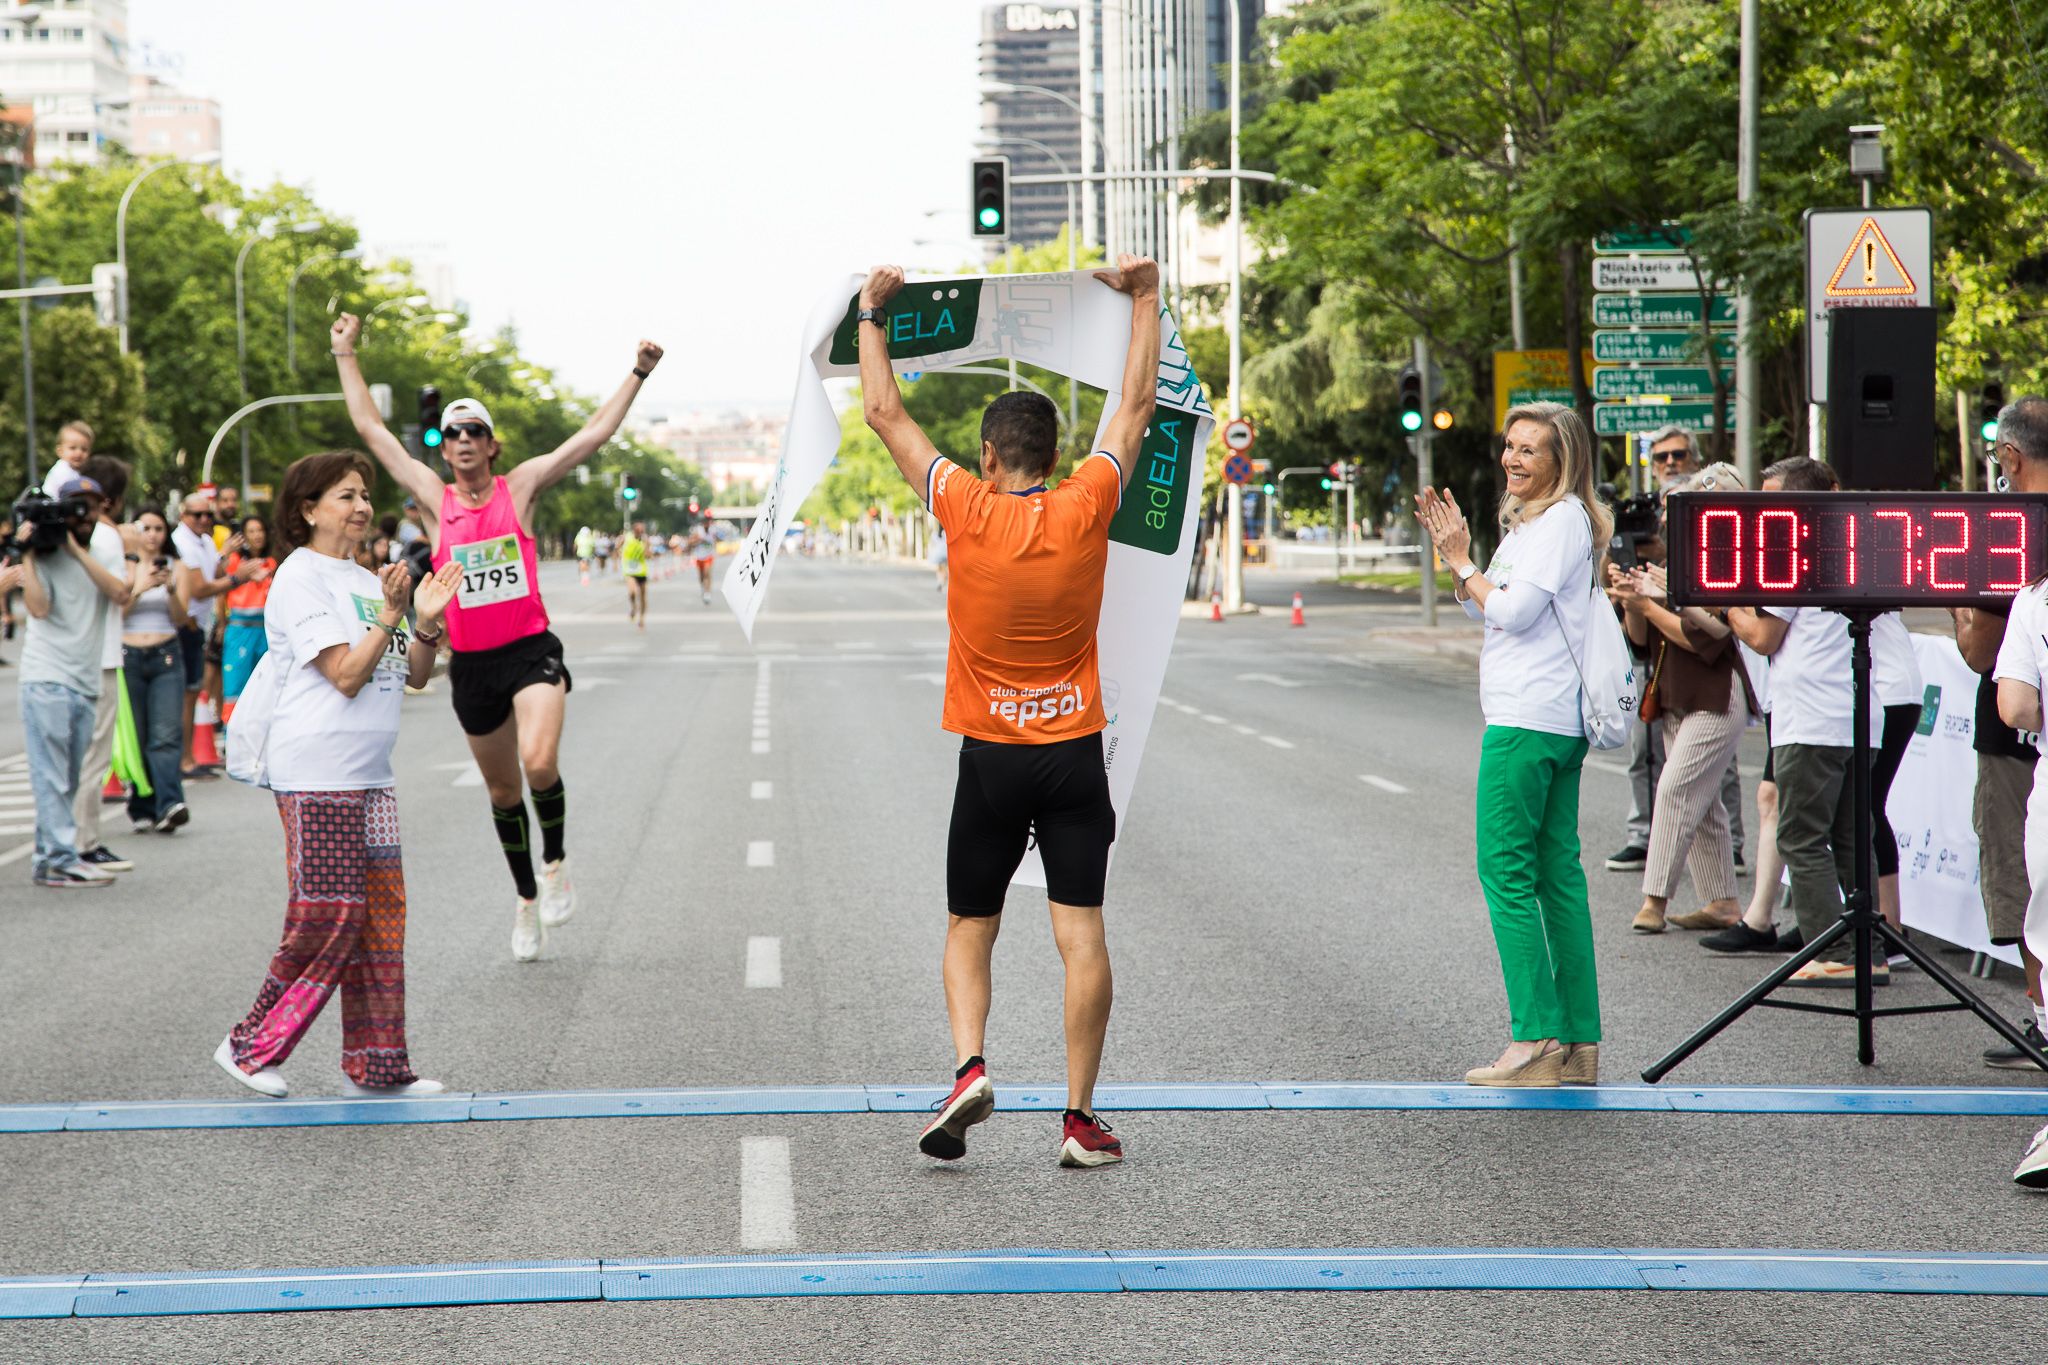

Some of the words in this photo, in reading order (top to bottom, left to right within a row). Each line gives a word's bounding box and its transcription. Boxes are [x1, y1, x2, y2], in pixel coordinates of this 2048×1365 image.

[1599, 261, 1672, 273] Ministerio
[1599, 274, 1658, 286] Defensa
[1598, 298, 1626, 309] calle
[1628, 297, 1643, 309] de
[1598, 309, 1629, 323] San
[1630, 308, 1694, 323] Germán
[1598, 334, 1632, 345] calle
[1634, 335, 1651, 345] de
[1599, 344, 1654, 357] Alberto
[1598, 371, 1632, 382] calle
[1634, 370, 1655, 382] del
[1598, 381, 1640, 394] Padre
[1598, 407, 1633, 419] plaza
[1636, 406, 1654, 418] de
[1655, 406, 1669, 418] la
[1616, 416, 1701, 429] Dominicana
[1145, 419, 1182, 530] adELA
[466, 543, 508, 569] ELA
[1699, 509, 2027, 590] 00:17:23
[464, 564, 519, 594] 1795
[989, 686, 1017, 698] club
[989, 685, 1086, 728] repsol
[1105, 736, 1119, 770] EVENTOS
